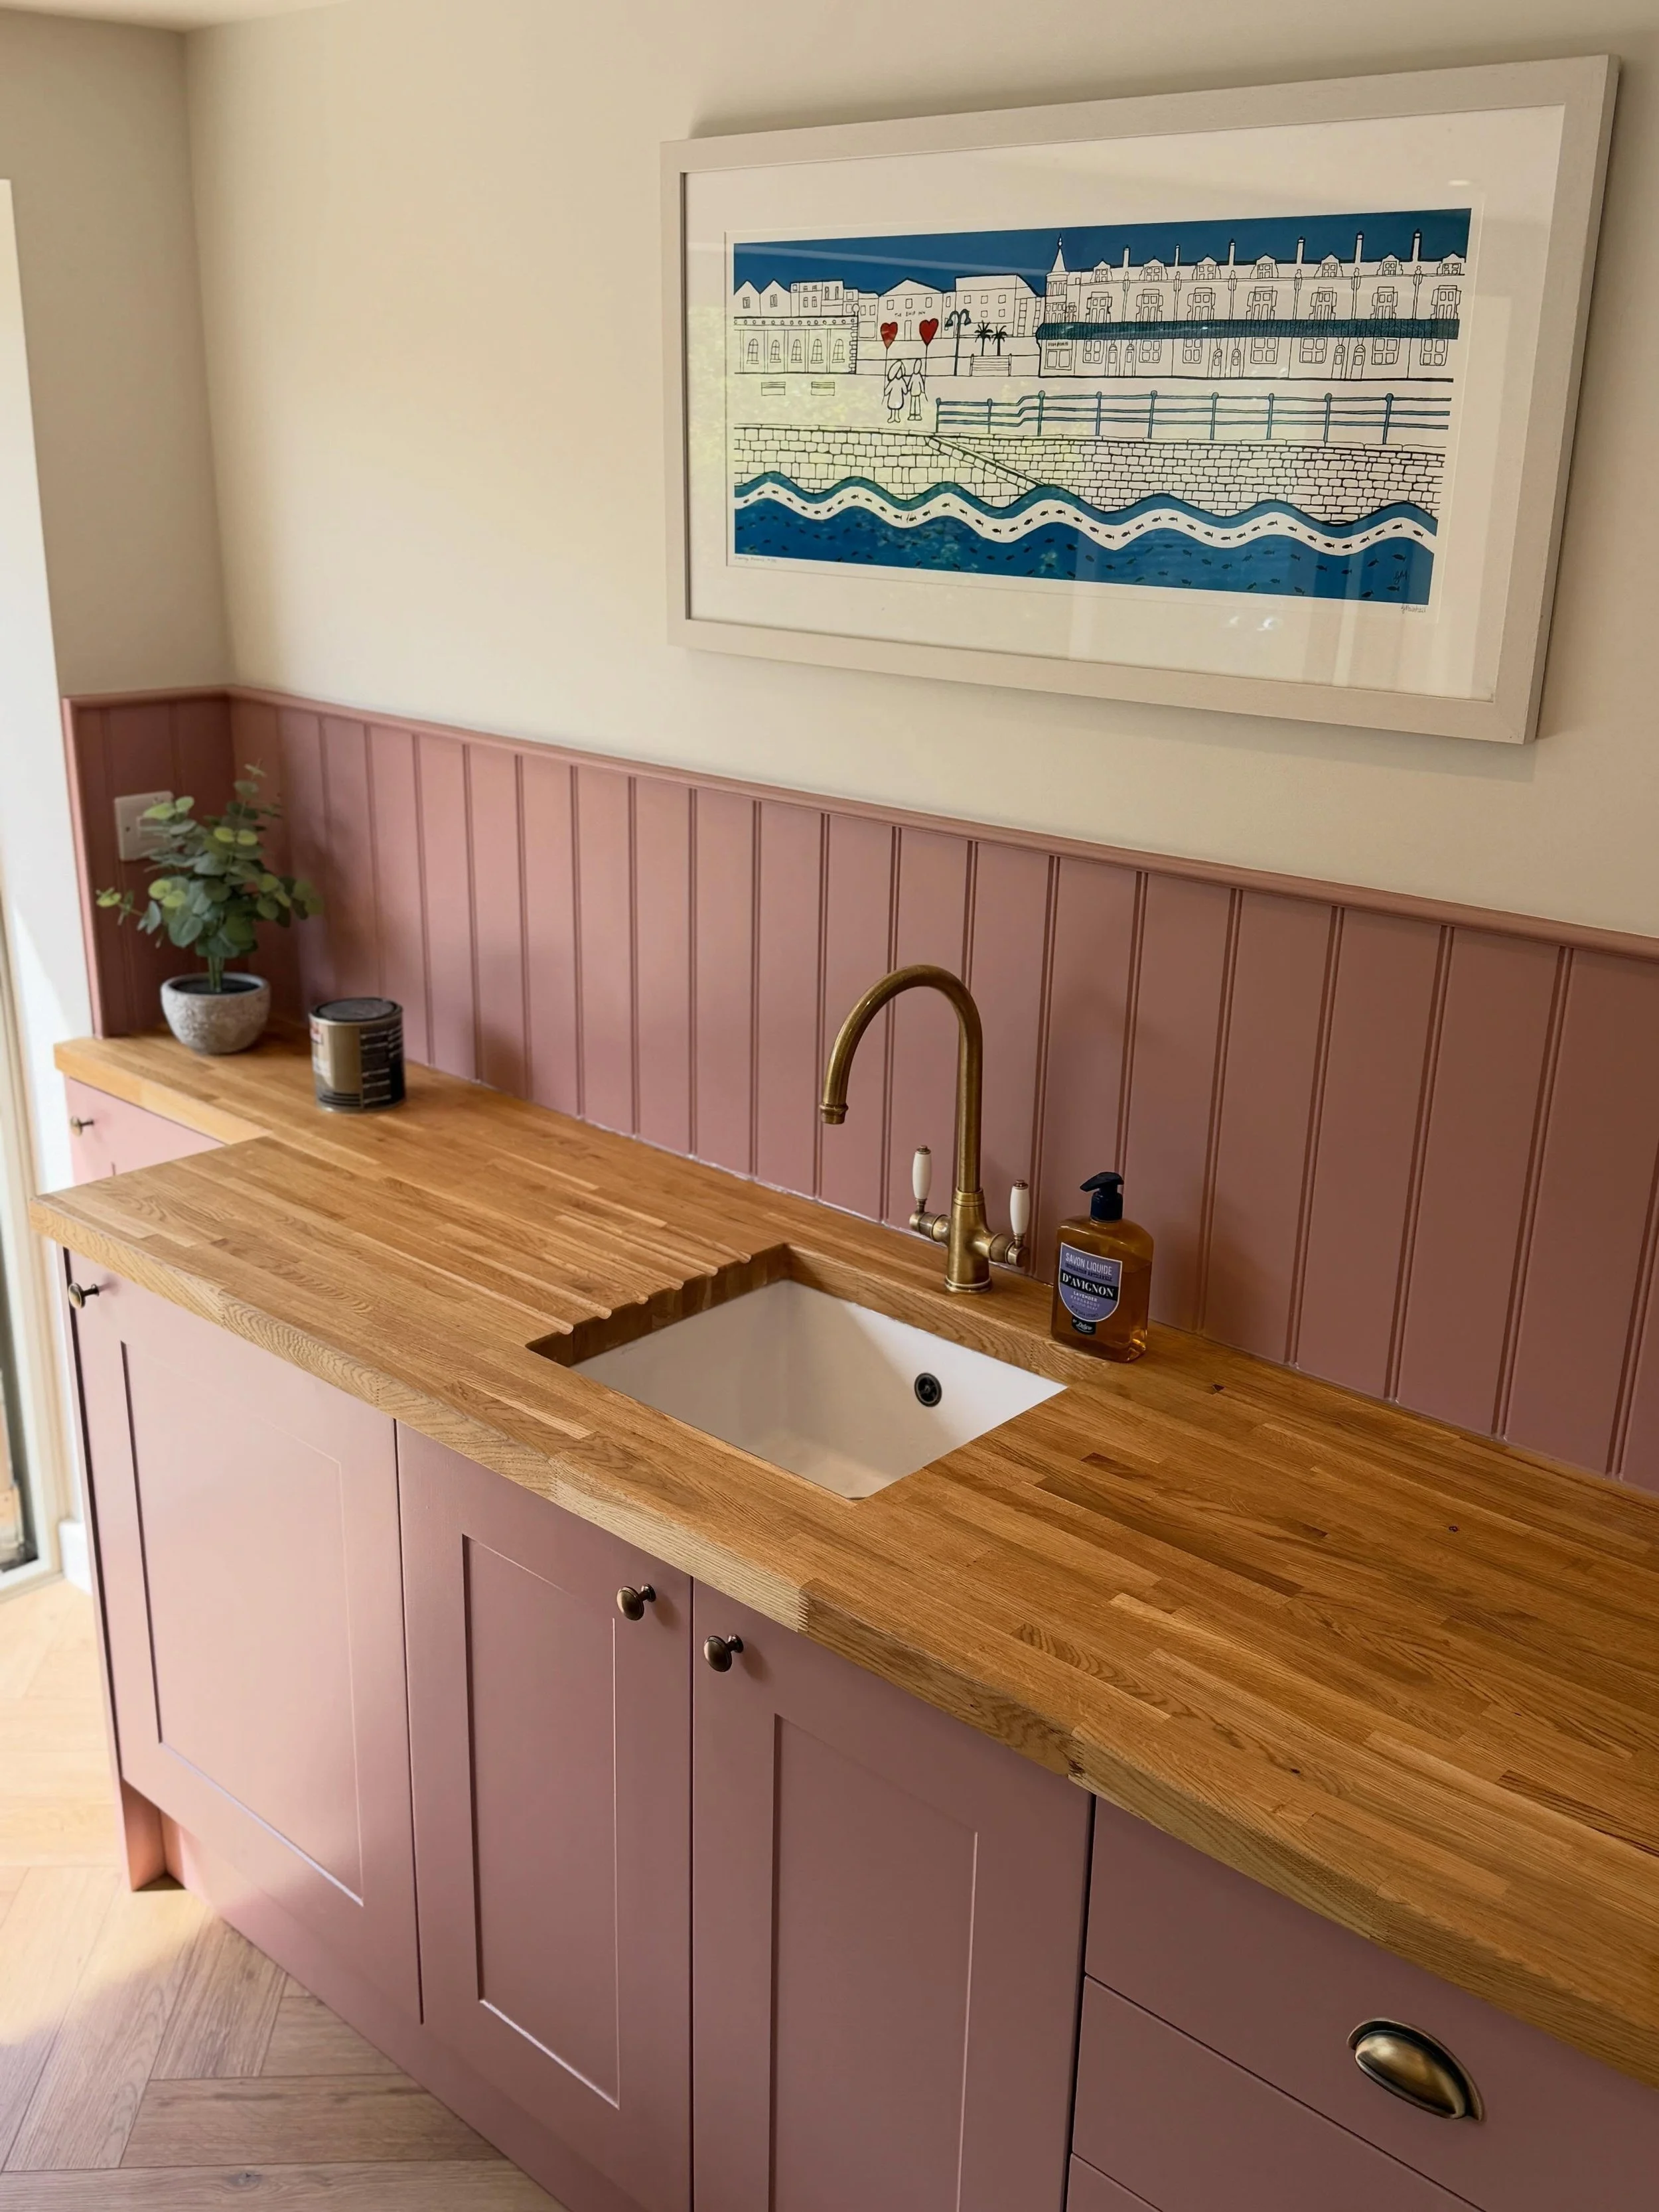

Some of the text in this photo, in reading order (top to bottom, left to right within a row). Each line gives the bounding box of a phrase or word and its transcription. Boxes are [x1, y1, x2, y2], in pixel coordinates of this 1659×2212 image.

[1066, 1252, 1085, 1268] SAVON
[1086, 1260, 1113, 1276] LIQUIDE
[1062, 1272, 1115, 1297] D'AVIGNON
[1073, 1291, 1098, 1302] LAVENDER
